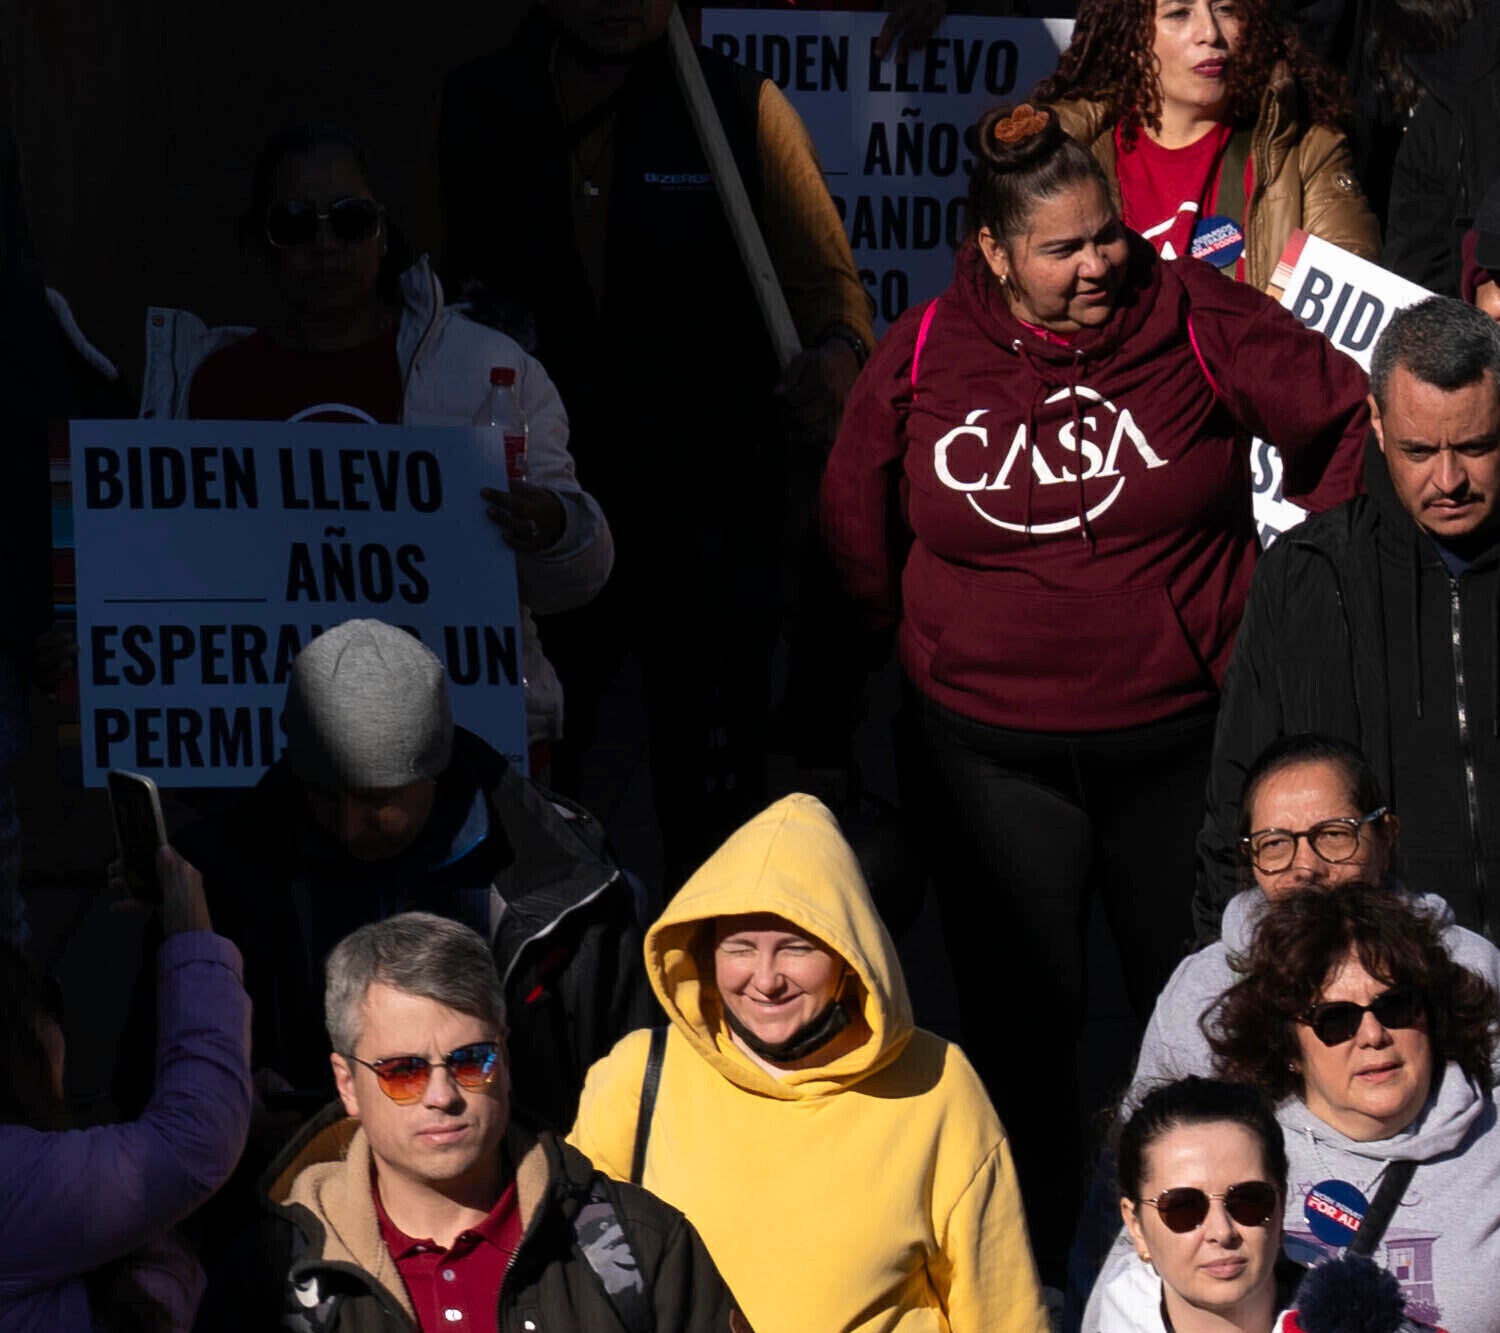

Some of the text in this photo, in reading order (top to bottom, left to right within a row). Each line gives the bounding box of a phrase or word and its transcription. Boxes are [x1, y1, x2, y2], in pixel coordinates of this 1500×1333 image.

[868, 38, 1017, 97] LLEVO
[84, 446, 443, 514] BIDEN LLEVO
[933, 408, 1169, 492] CASA
[285, 527, 430, 604] AÑOS
[446, 624, 519, 687] UN
[94, 706, 288, 769] PERMI
[1308, 1196, 1337, 1220] FOR
